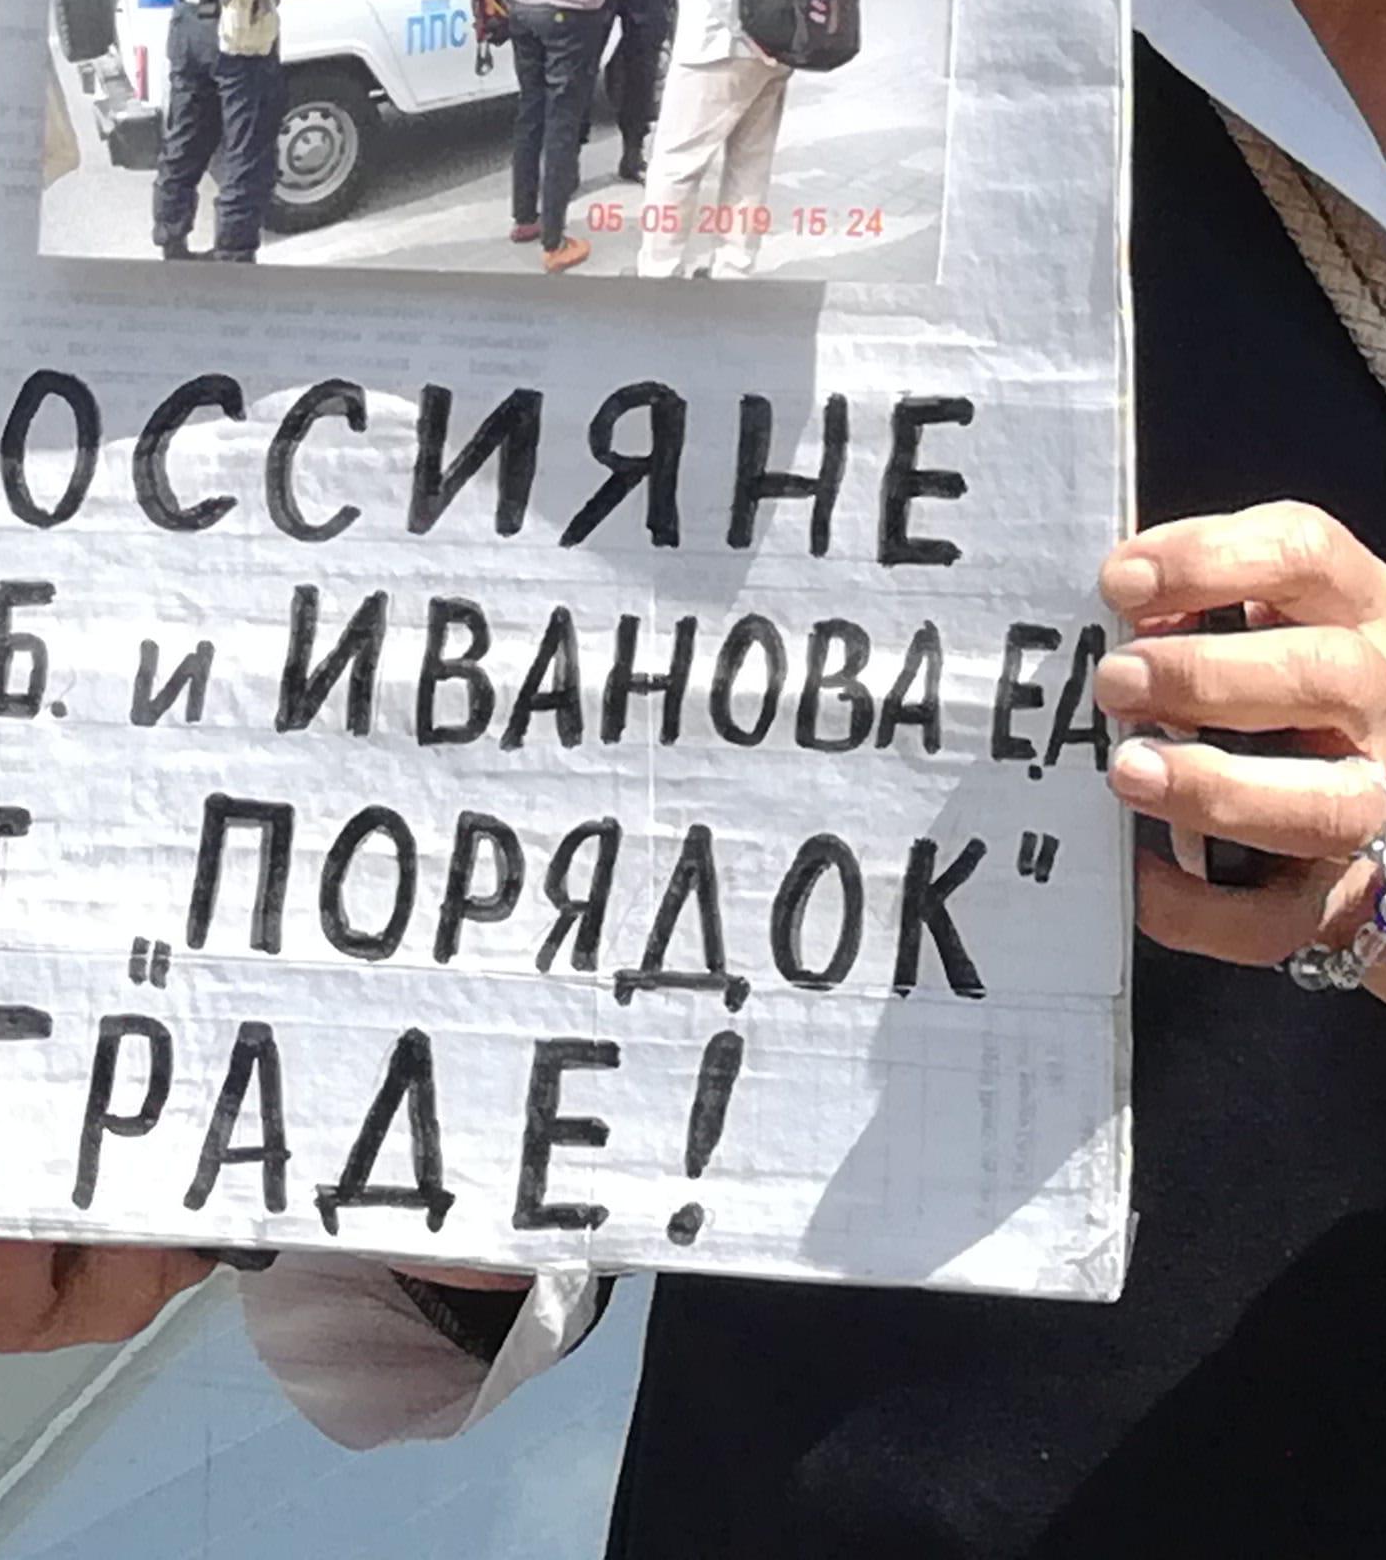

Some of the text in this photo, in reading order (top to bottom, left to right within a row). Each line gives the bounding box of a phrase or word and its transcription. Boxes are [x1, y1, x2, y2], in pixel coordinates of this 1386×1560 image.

[406, 9, 469, 57] ППС
[697, 205, 772, 235] 2019
[275, 586, 941, 753] ИВАНОВА
